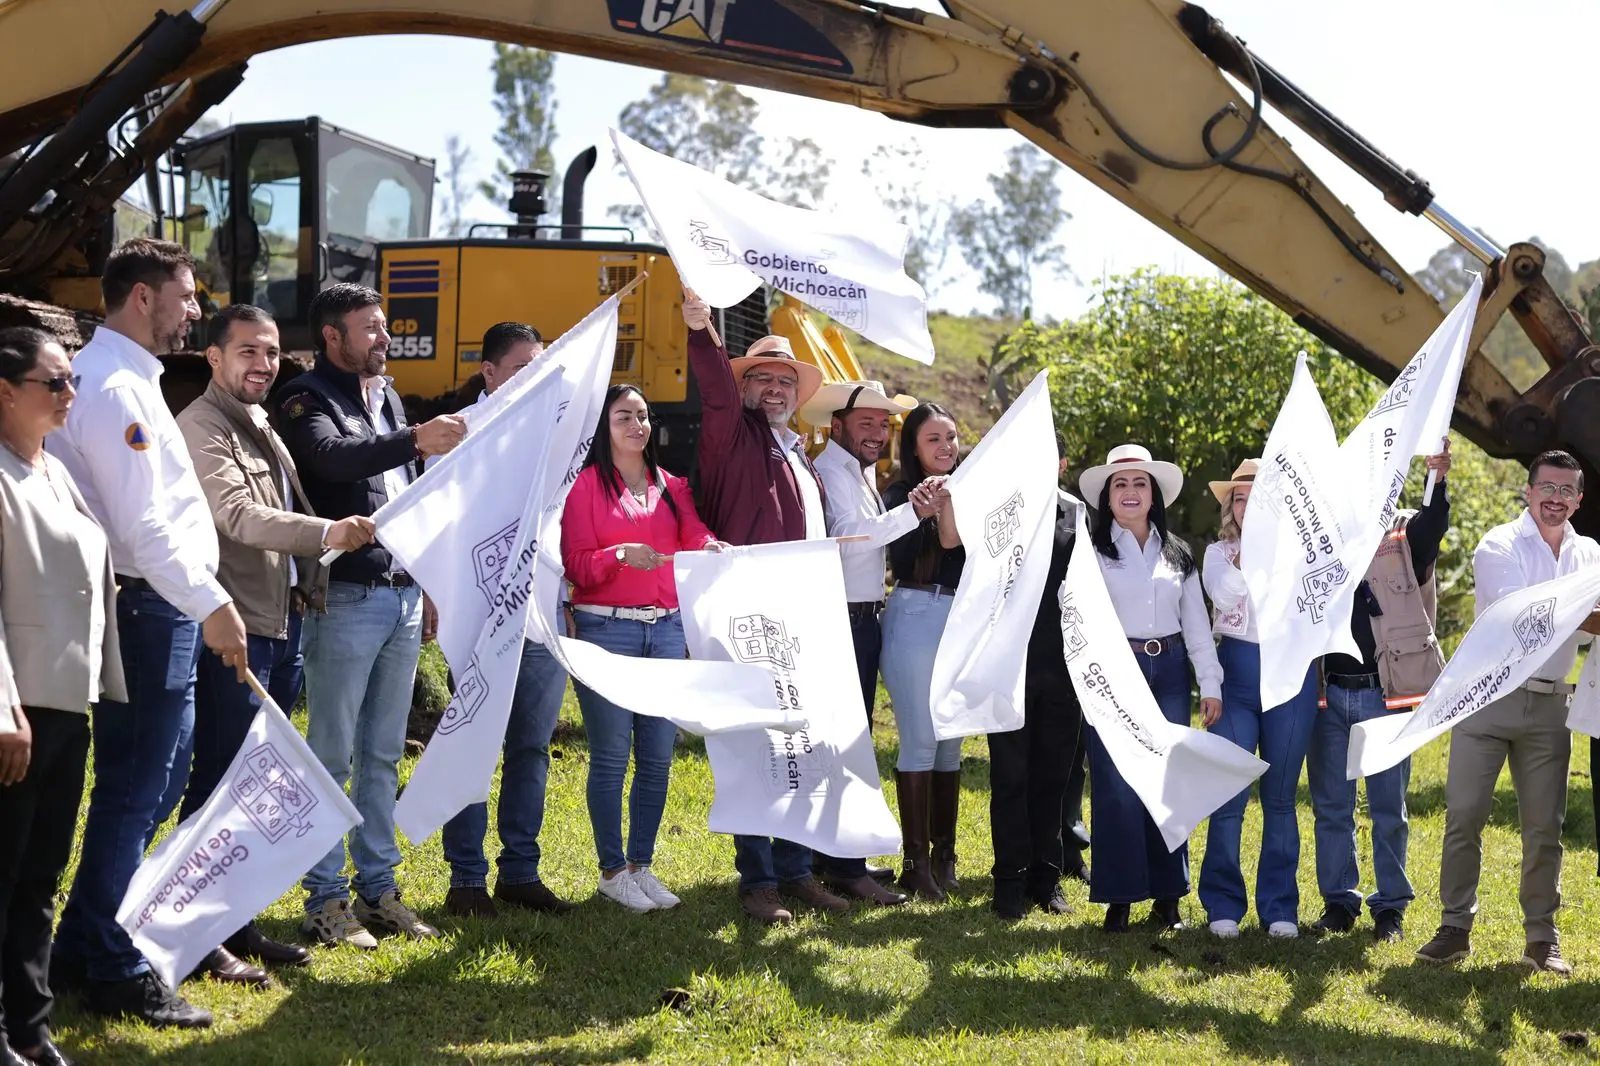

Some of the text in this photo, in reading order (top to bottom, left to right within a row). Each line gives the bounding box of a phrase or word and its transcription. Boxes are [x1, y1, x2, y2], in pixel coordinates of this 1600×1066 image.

[641, 0, 737, 44] CAT
[744, 249, 828, 275] Gobierno
[771, 275, 867, 299] Michoacán
[391, 319, 418, 335] GD
[388, 336, 433, 358] 555
[1384, 427, 1397, 447] de
[1275, 453, 1325, 534] Michoacán
[1284, 494, 1317, 564] Gobierno
[1320, 534, 1334, 555] de
[135, 828, 232, 929] de Michoacán
[173, 845, 249, 913] Gobierno
